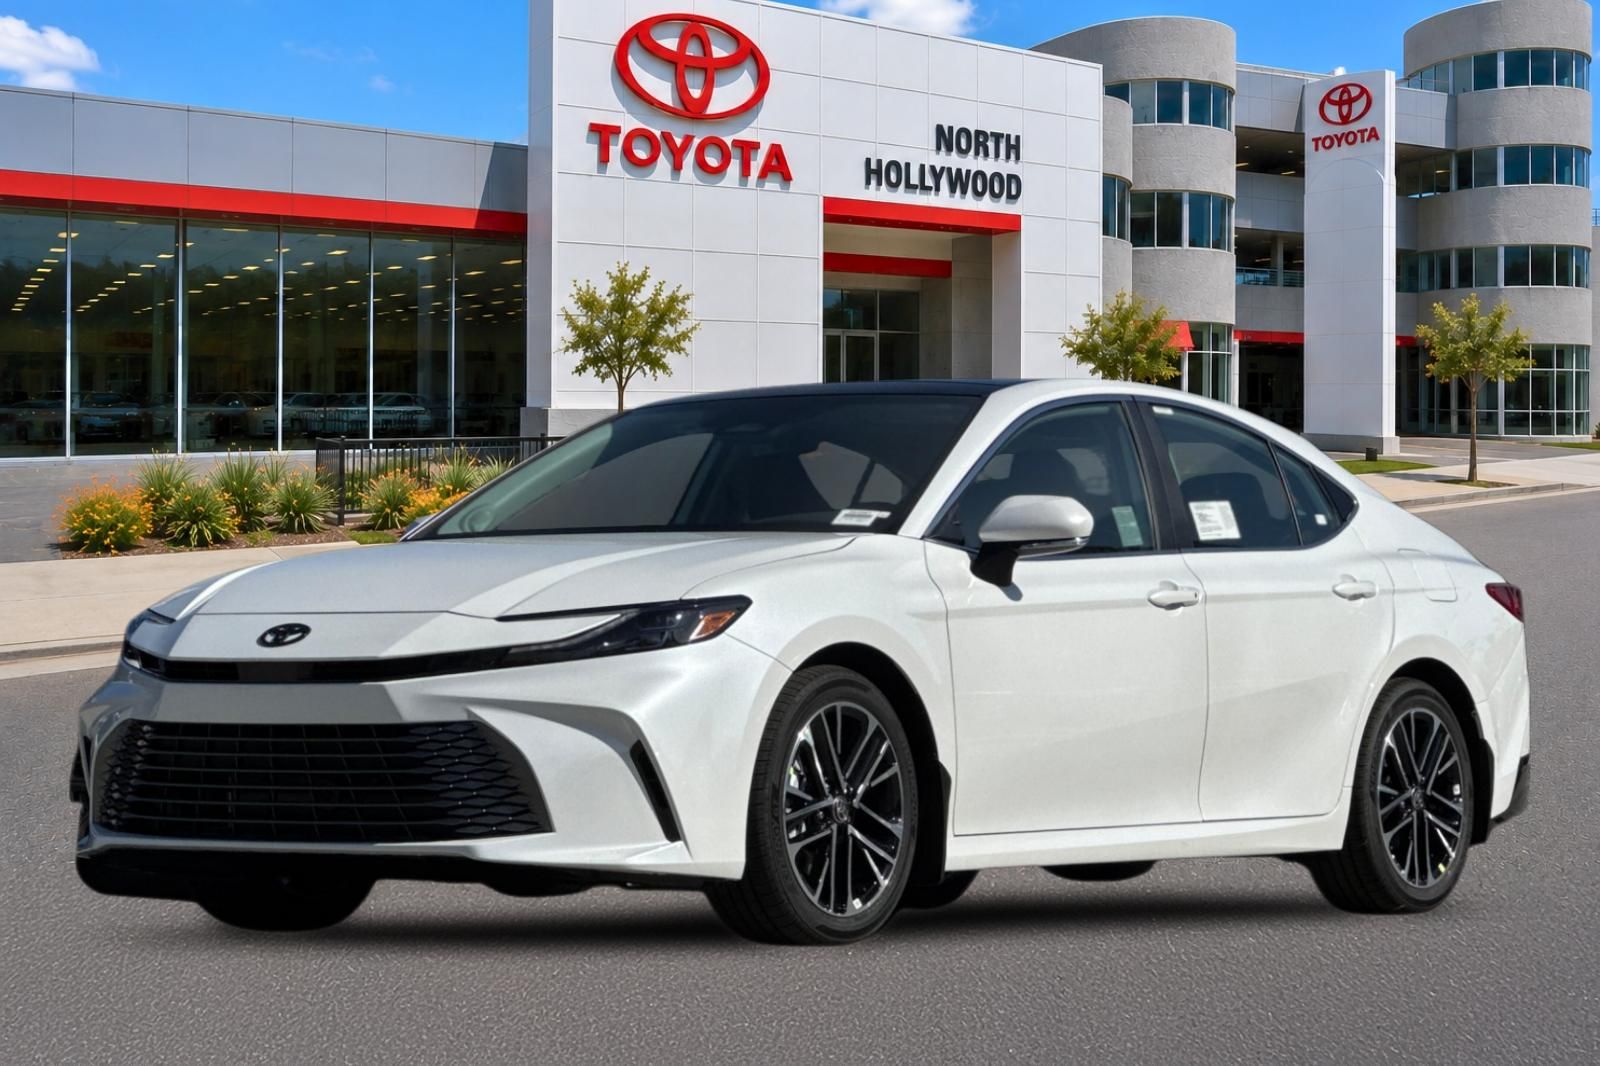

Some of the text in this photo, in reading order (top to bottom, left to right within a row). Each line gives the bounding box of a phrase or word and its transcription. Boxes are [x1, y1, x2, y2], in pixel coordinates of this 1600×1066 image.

[588, 122, 793, 182] TOYOTA
[935, 124, 1022, 161] NORTH
[1311, 126, 1380, 152] TOYOTA
[864, 157, 1023, 201] HOLLYWOOD
